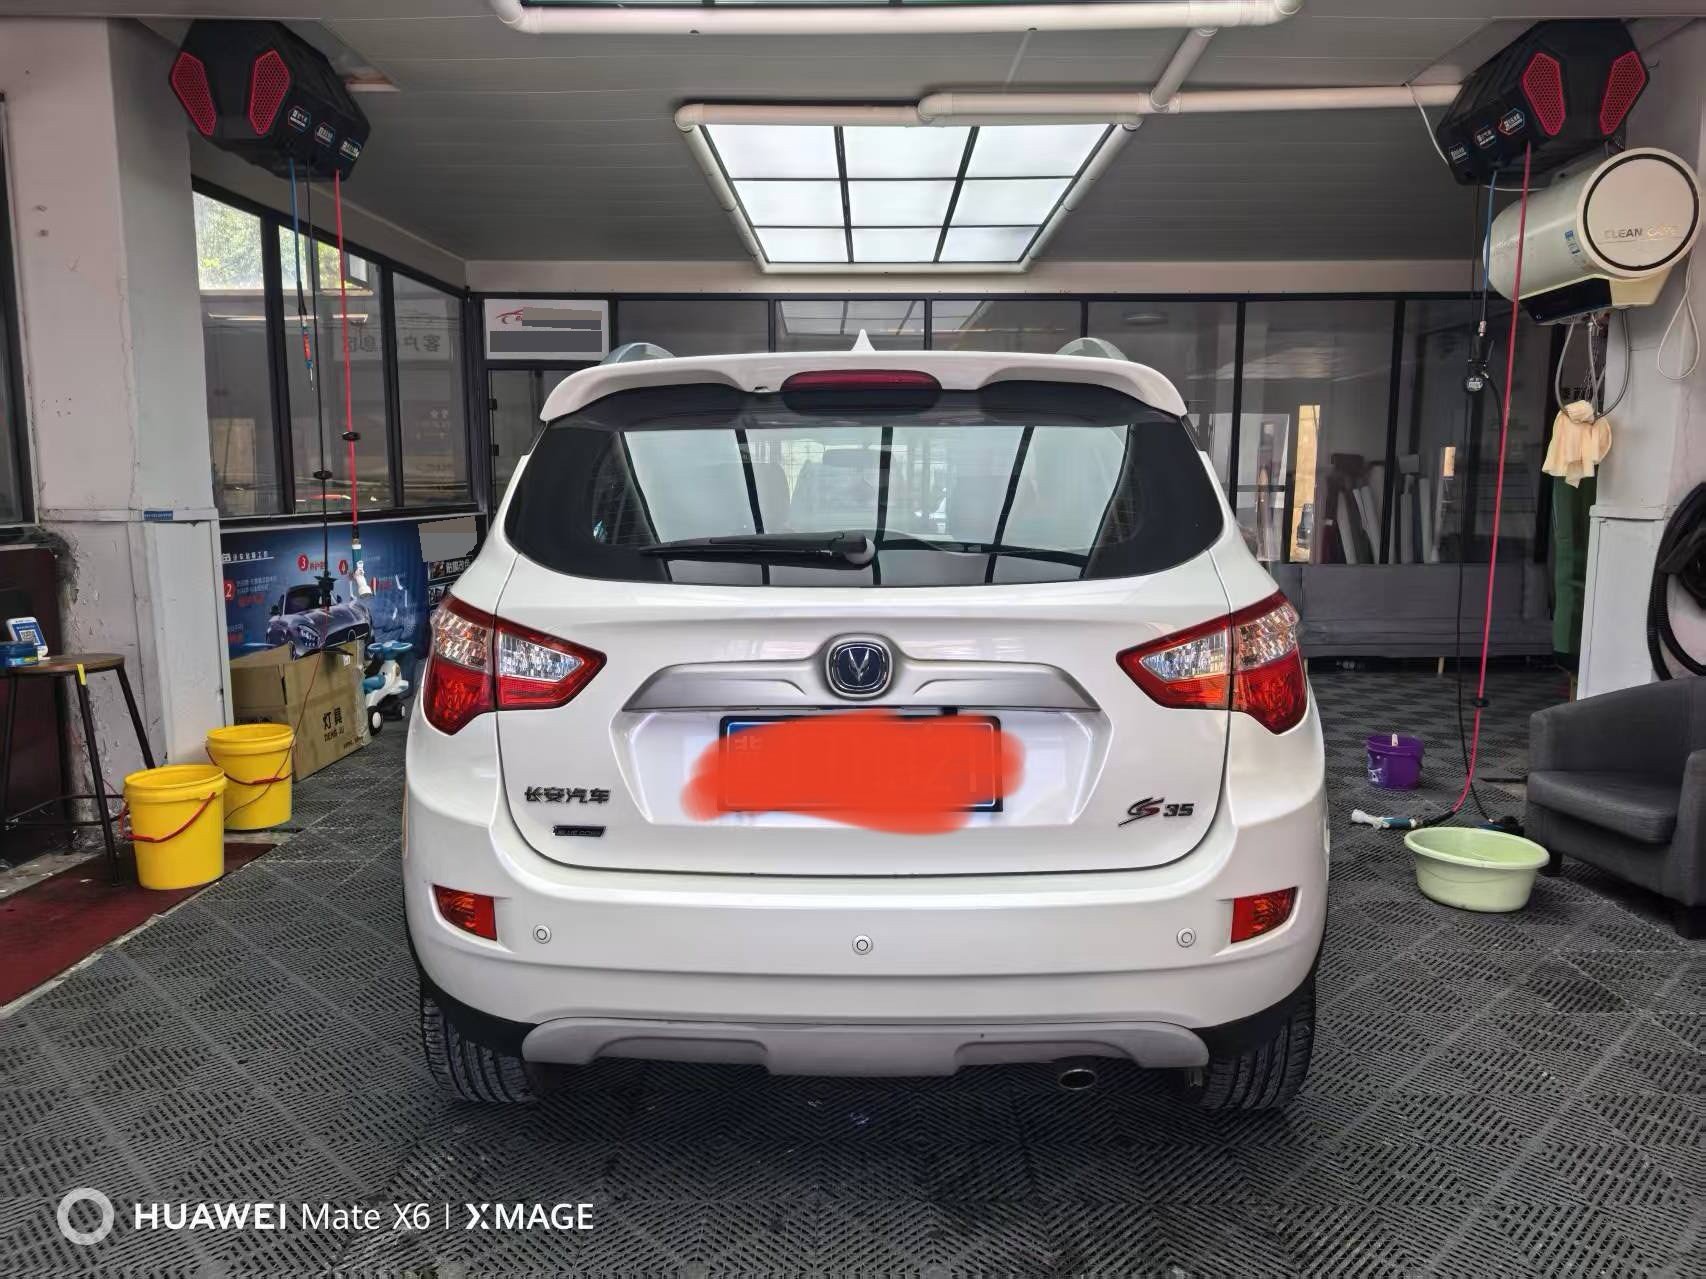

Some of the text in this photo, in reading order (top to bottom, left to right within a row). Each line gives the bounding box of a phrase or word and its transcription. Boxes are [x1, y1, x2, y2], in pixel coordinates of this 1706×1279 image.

[1604, 228, 1643, 239] CLEAN
[525, 786, 610, 804] 长安汽车
